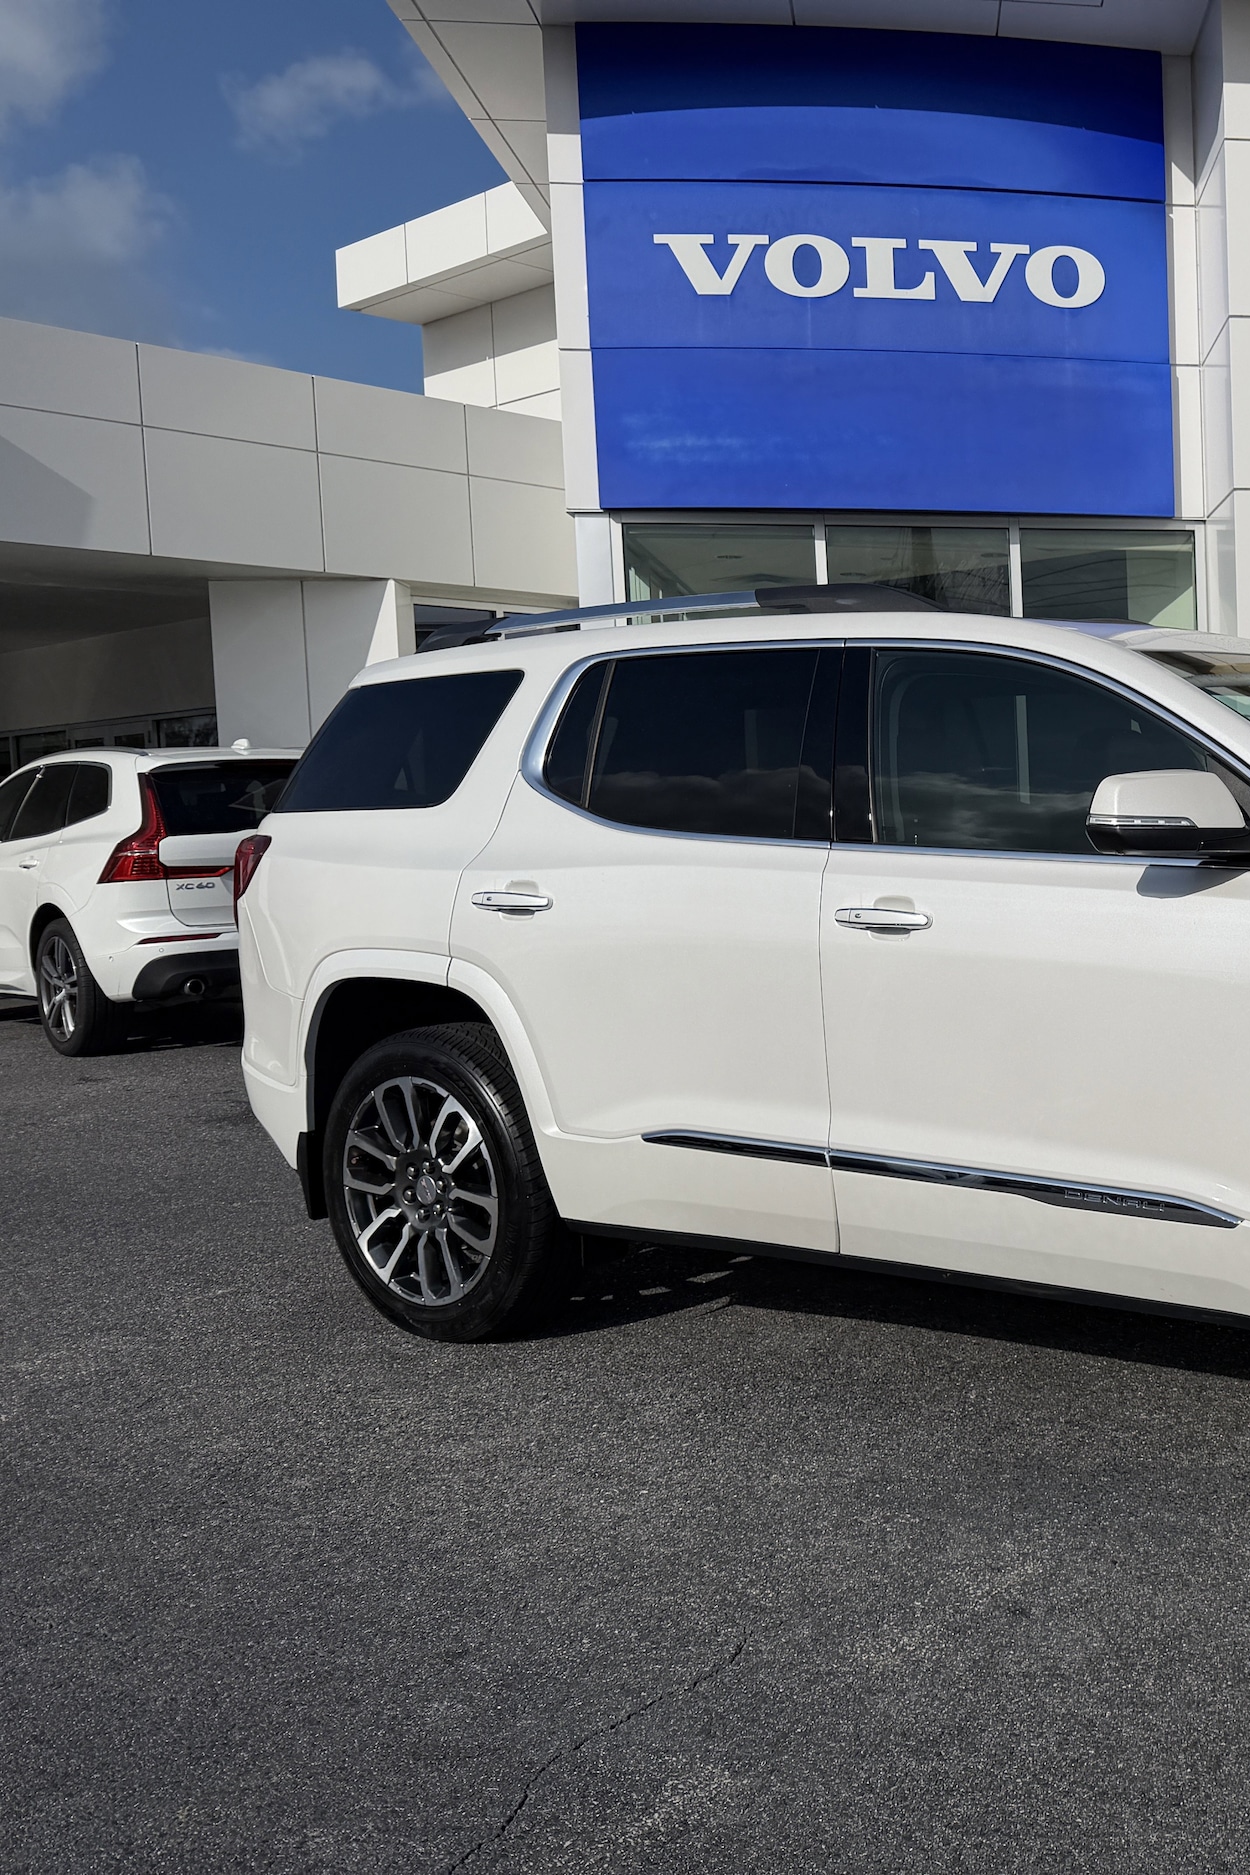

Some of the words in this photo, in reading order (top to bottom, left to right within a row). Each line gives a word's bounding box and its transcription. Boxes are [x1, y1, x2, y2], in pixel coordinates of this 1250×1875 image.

[653, 234, 1106, 308] VOLVO
[176, 882, 215, 890] XC60
[1064, 1189, 1165, 1212] DENALI
